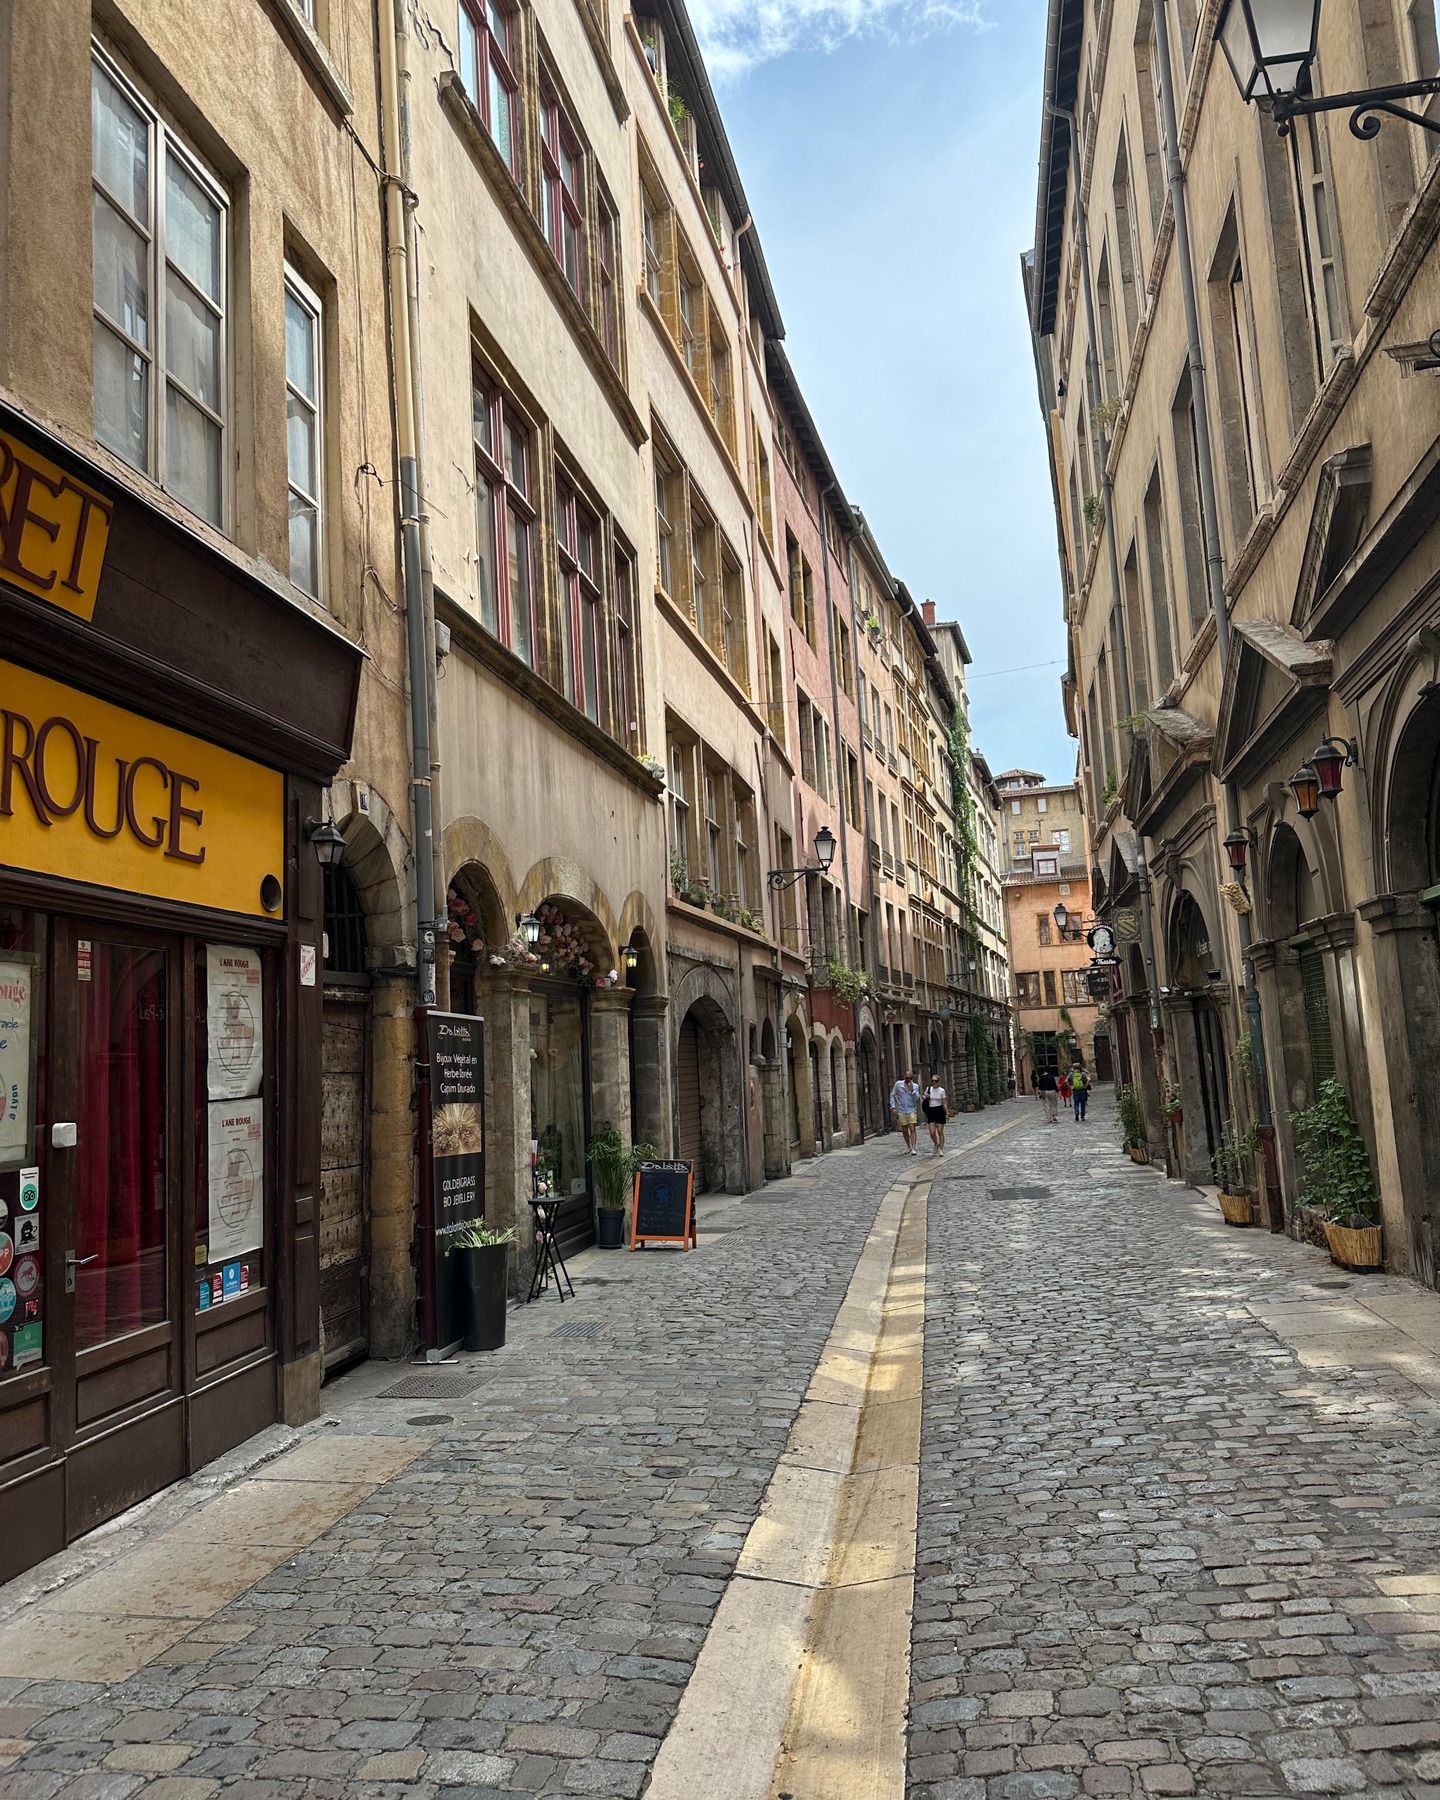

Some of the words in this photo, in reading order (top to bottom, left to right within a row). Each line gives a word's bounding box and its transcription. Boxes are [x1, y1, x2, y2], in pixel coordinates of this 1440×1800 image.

[0, 708, 206, 865] ROUGE
[471, 1056, 478, 1065] en
[443, 1196, 452, 1208] BIO
